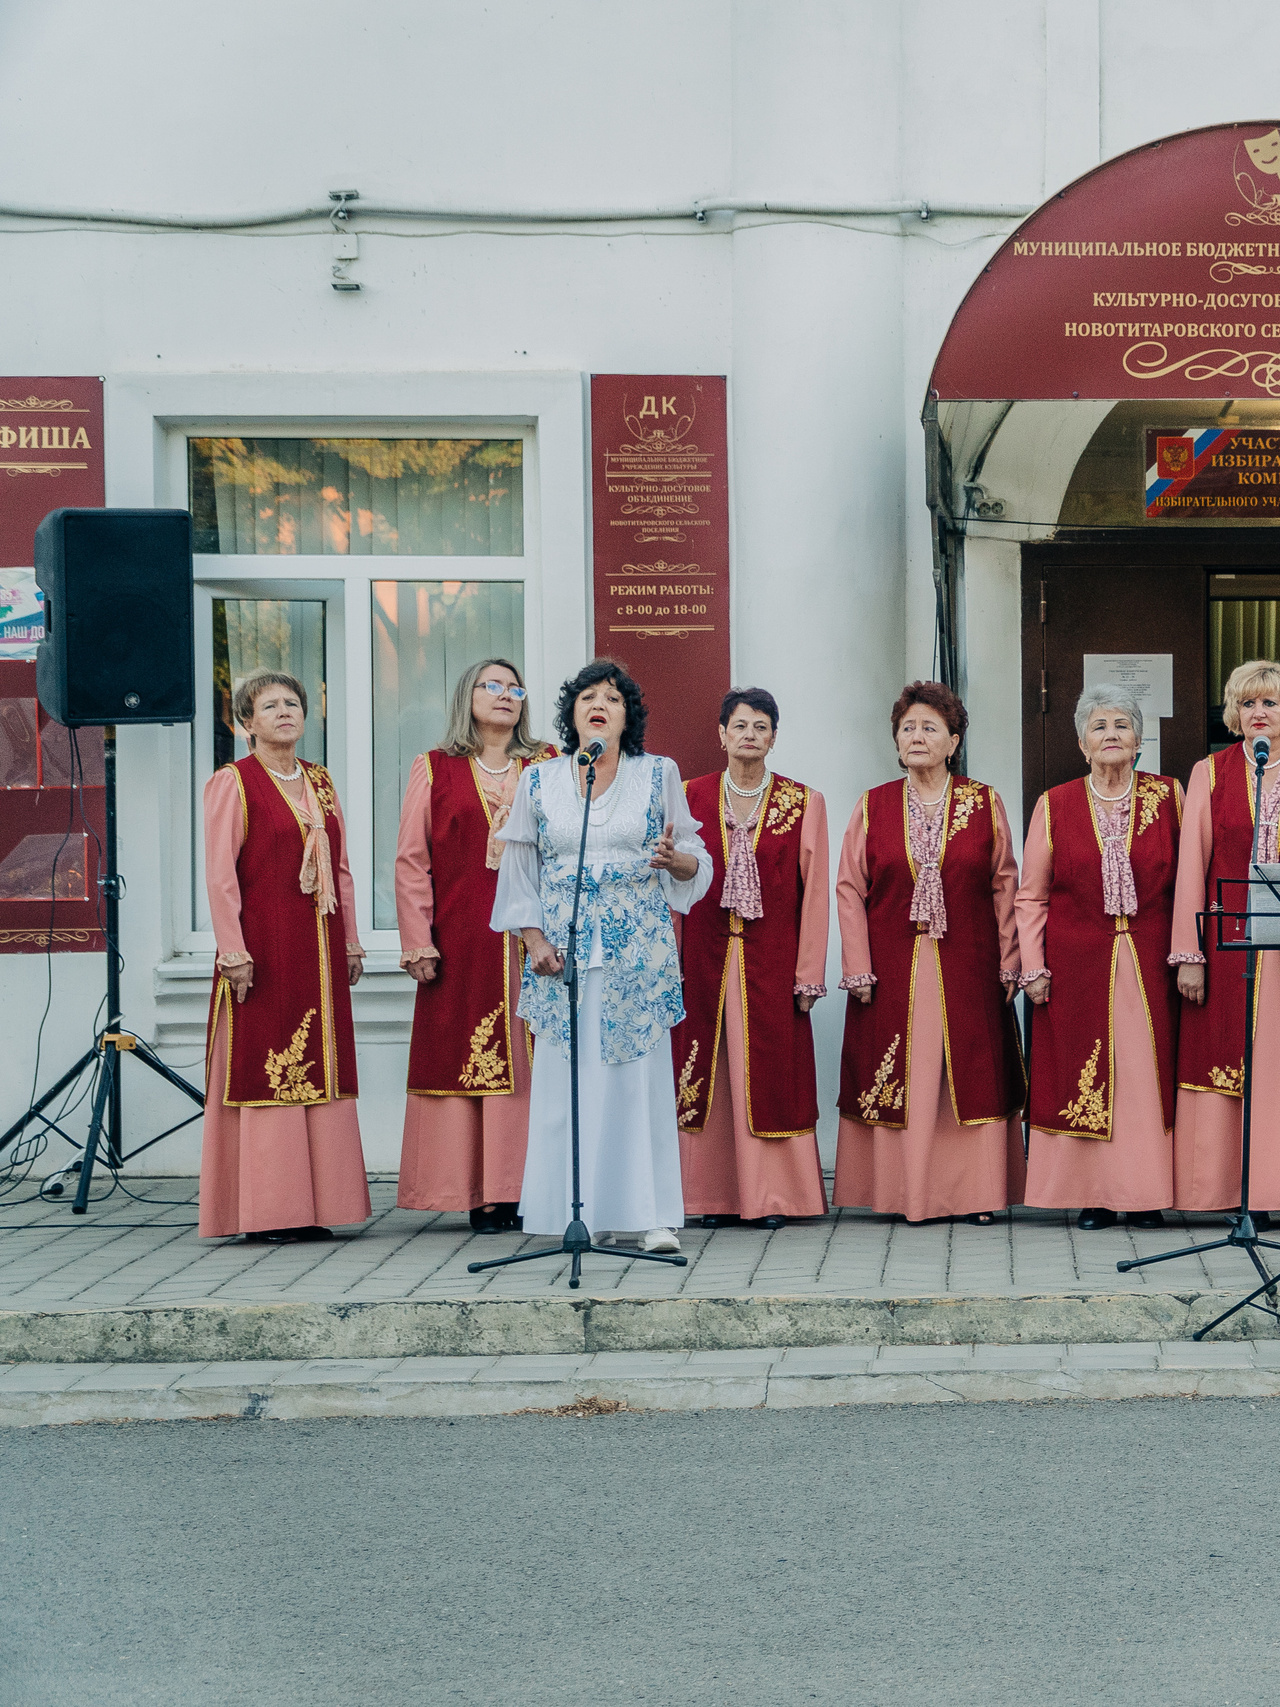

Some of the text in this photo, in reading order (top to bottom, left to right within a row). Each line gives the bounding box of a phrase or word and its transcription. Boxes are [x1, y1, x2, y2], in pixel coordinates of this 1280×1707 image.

[1013, 240, 1181, 260] МУНИЦИПАЛЬНОЕ
[1064, 321, 1257, 339] НОВОТИТАРОВСКОГО
[639, 395, 677, 419] ДК
[608, 485, 711, 493] КУЛЬТУРНО-ДОСУГОВОЕ
[627, 495, 693, 503] ОБЪЕДИНЕНИЕ
[1155, 496, 1258, 507] ИЗБИРАТЕЛЬНОГО
[610, 585, 714, 596] РЕЖИМ РАБОТЫ:
[617, 604, 707, 616] с 8-00 до 18-00
[4, 626, 27, 638] НАШ
